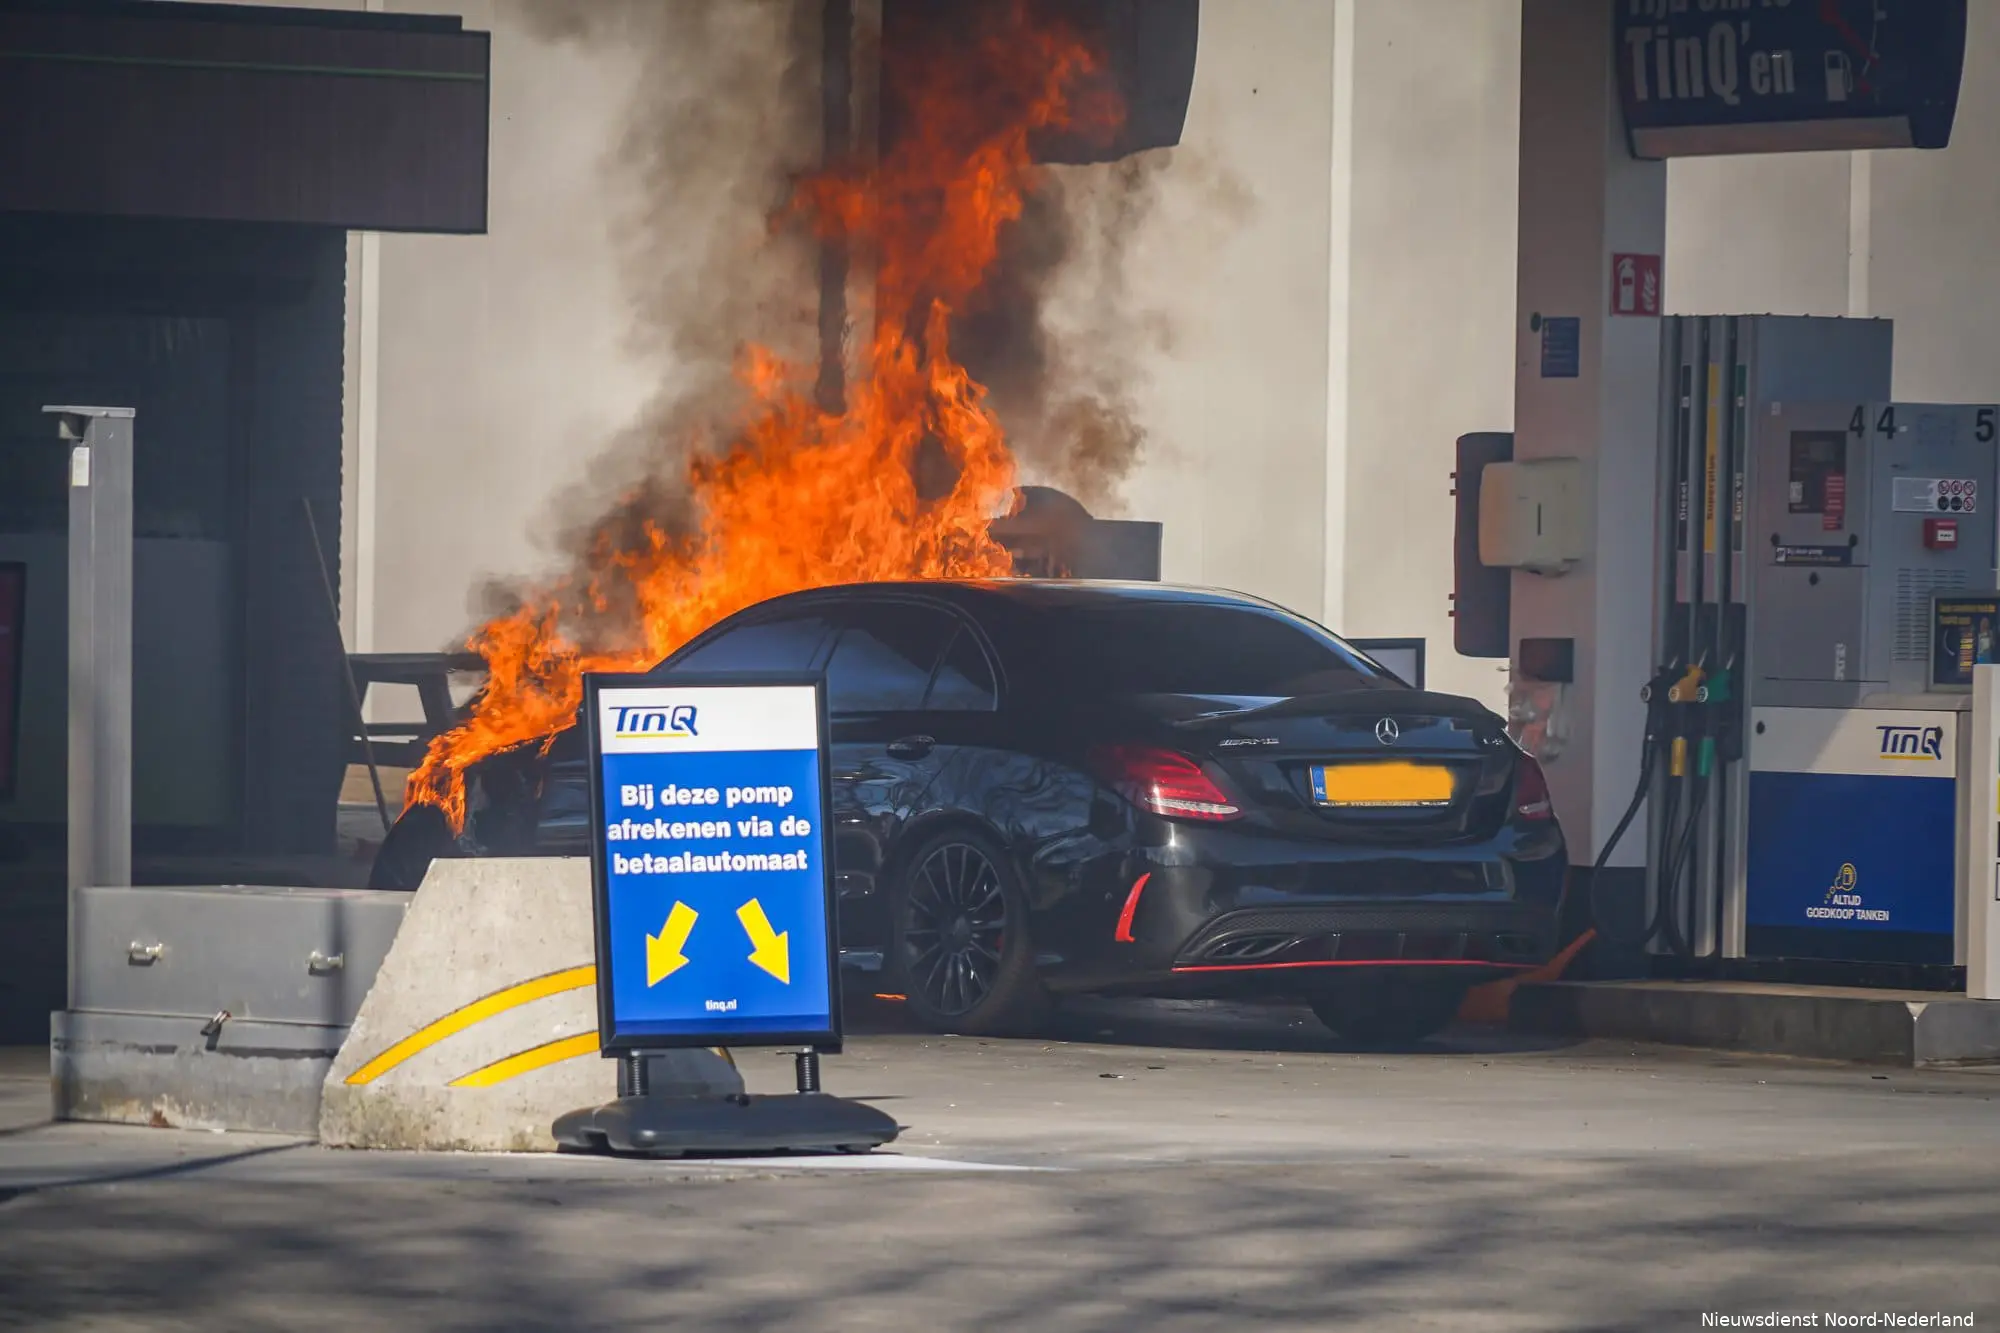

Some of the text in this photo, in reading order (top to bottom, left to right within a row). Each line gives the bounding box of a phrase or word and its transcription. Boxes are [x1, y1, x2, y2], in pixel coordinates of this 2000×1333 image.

[1625, 20, 1796, 105] TinQ'en
[1849, 404, 1865, 439] 4
[1876, 406, 1897, 439] 4
[1976, 408, 1995, 442] 5
[608, 705, 699, 736] TinQ
[1876, 726, 1943, 760] TinQ
[620, 784, 793, 810] Bij deze pomp
[1315, 786, 1325, 795] NL
[607, 815, 811, 841] afrekenen via de
[613, 849, 808, 875] betaalautomaat
[1832, 894, 1862, 906] ALTIJD
[1806, 907, 1890, 921] GOEDKOOP TANKEN
[705, 998, 737, 1012] tinq.nl
